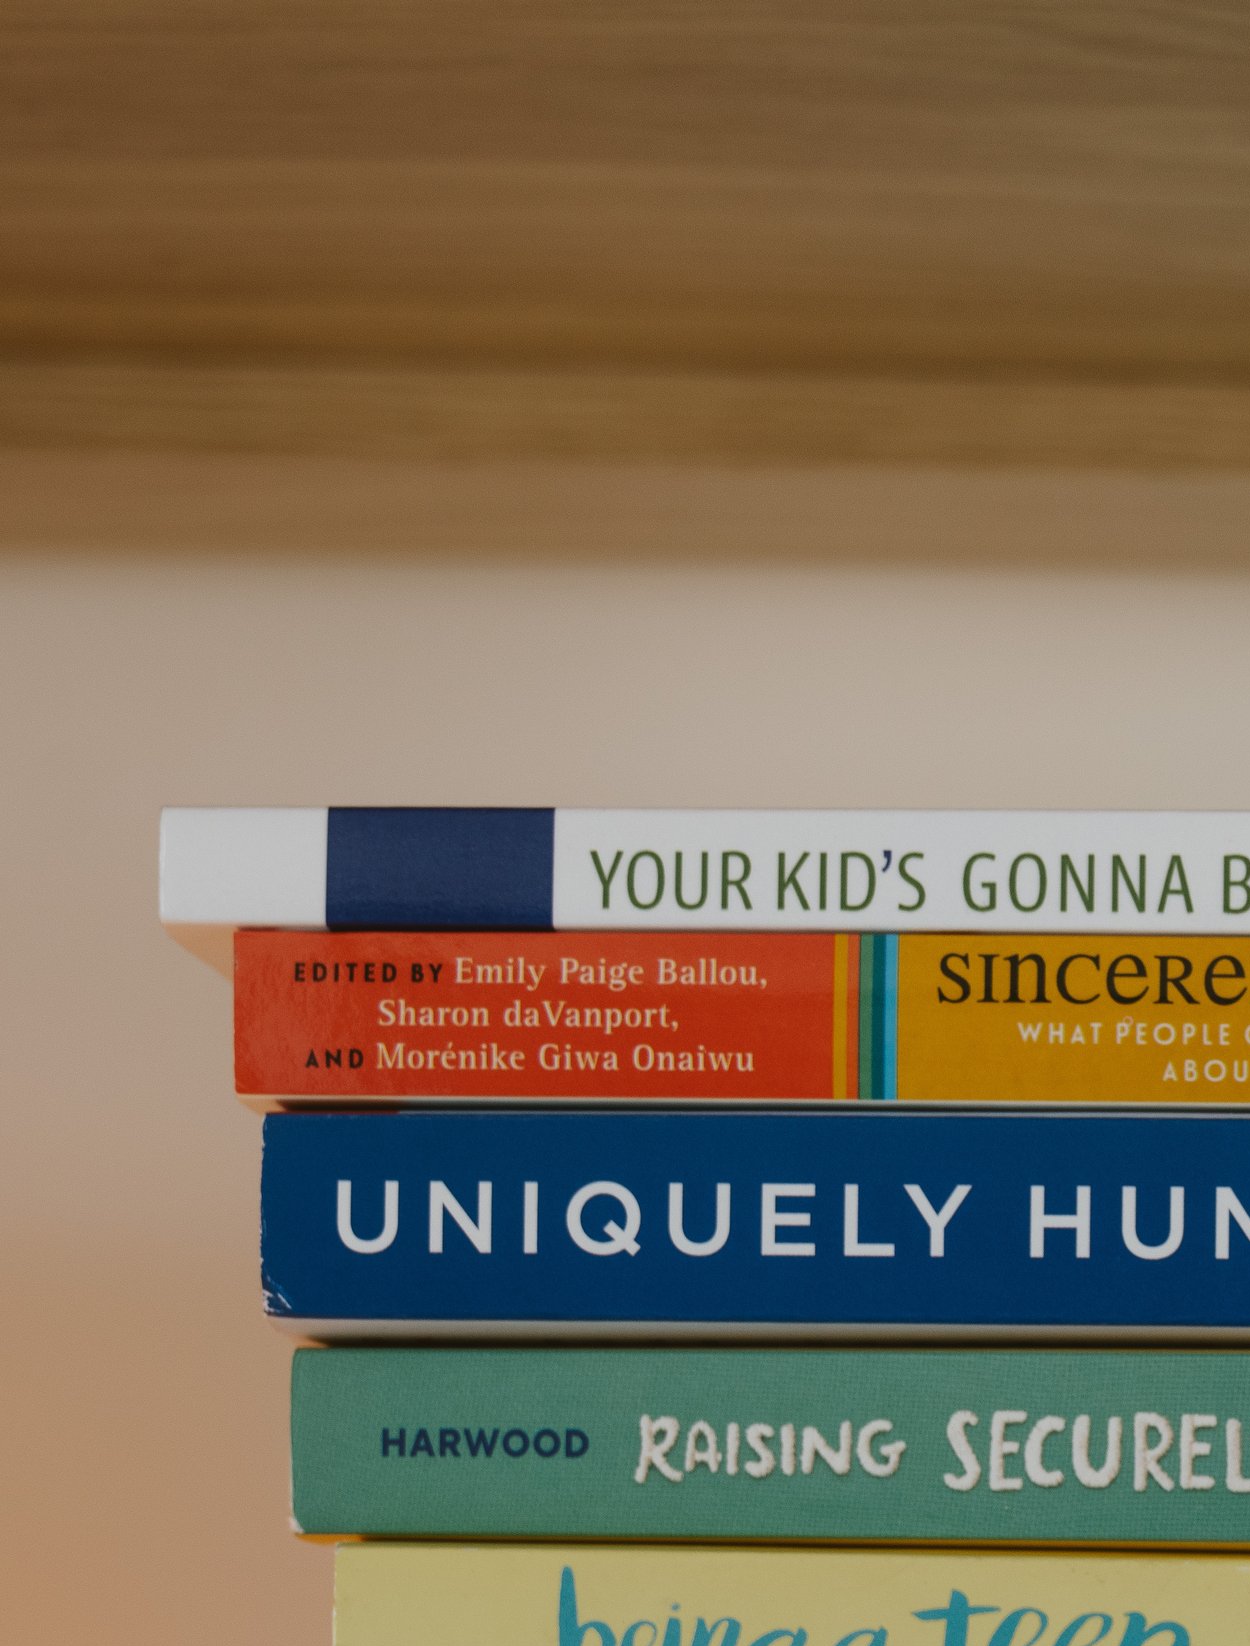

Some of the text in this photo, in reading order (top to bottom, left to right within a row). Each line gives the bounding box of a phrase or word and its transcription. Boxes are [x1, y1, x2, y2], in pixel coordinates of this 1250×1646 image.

[589, 849, 753, 911] YOUR
[776, 849, 926, 913] KID'S
[962, 852, 1194, 914] GONNA
[293, 956, 768, 991] EDITED BY Emily Paige Ballou,
[378, 998, 679, 1036] Sharon daVanport,
[1017, 1021, 1102, 1044] WHAT
[1115, 1022, 1230, 1046] PEOPLE
[305, 1041, 754, 1072] AND Morénike Giwa Onaiwu
[336, 1179, 972, 1258] UNIQUELY
[381, 1427, 590, 1459] HARWOOD
[633, 1414, 907, 1484] RAISING
